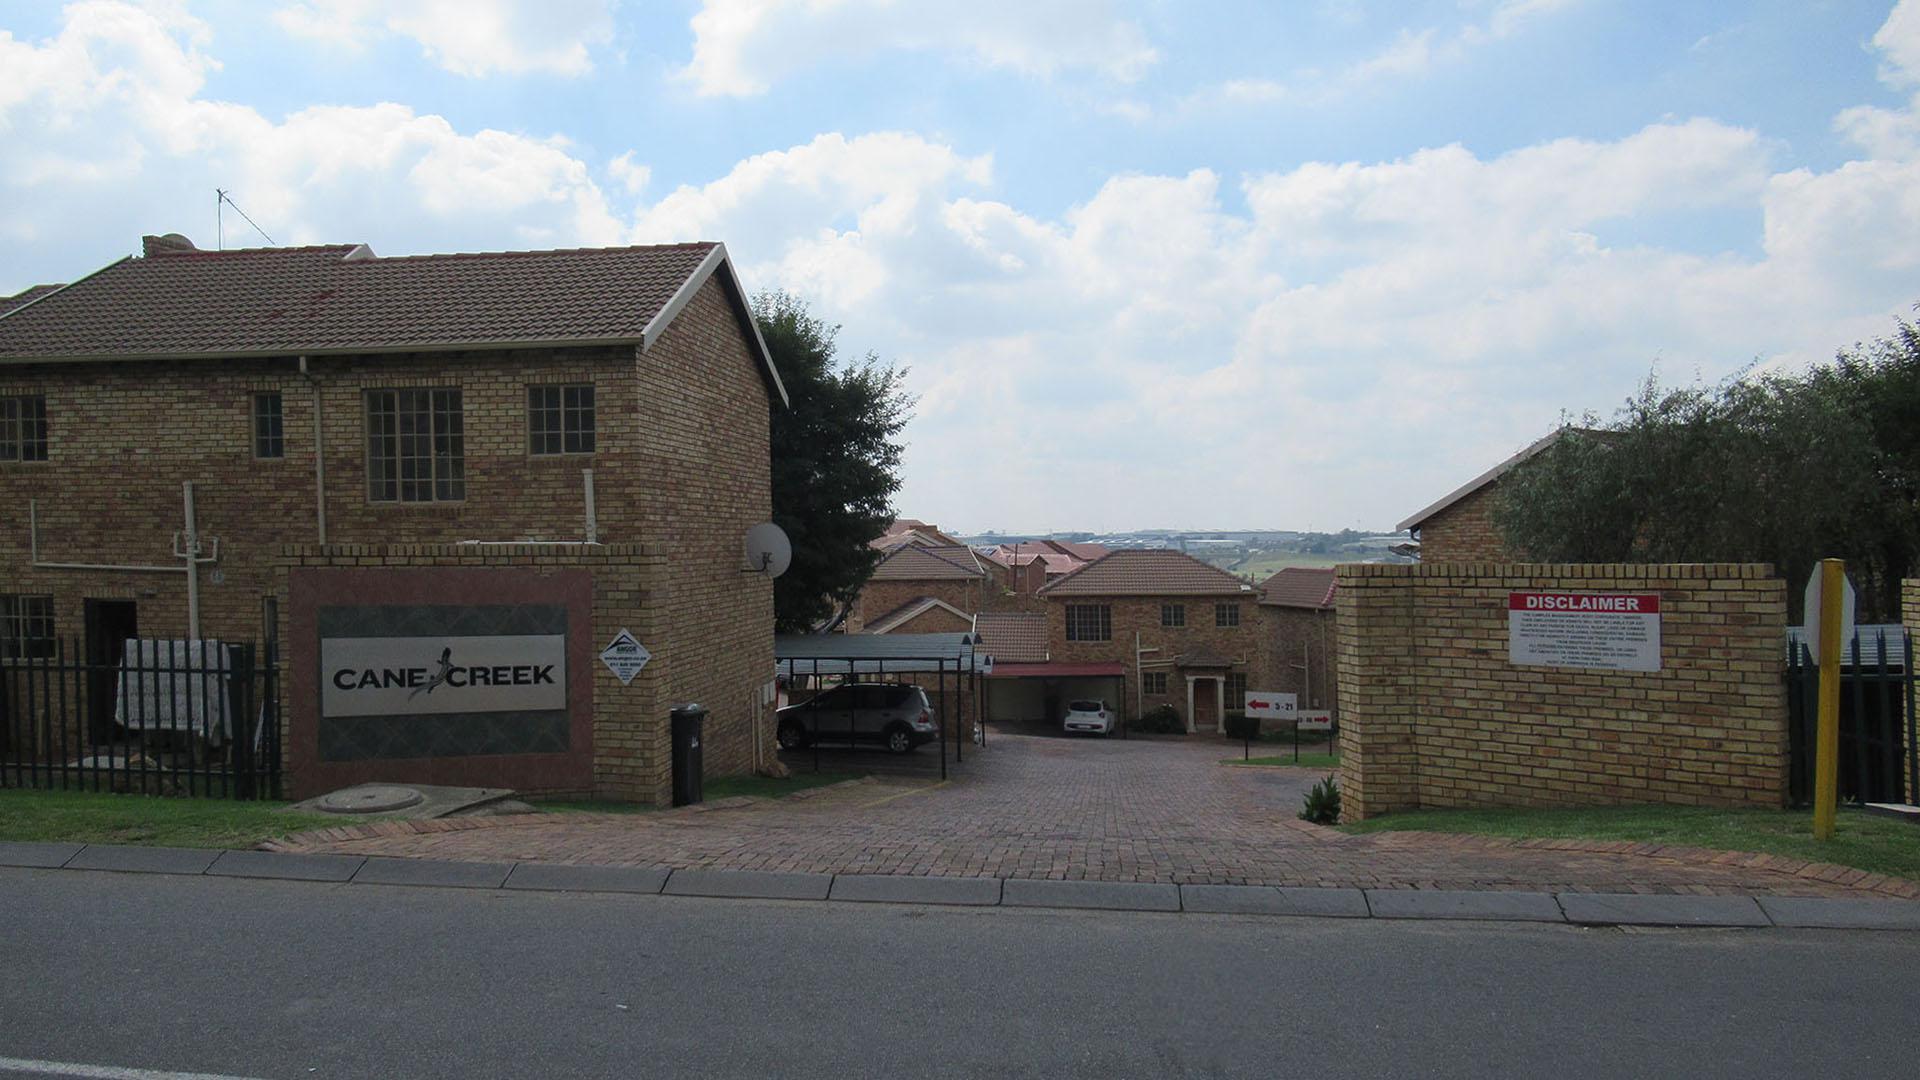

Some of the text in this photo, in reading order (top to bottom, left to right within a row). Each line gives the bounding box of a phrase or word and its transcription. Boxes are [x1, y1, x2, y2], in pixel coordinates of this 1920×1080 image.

[1526, 596, 1640, 611] DISCLAIMER
[333, 664, 556, 690] CANE CREEK
